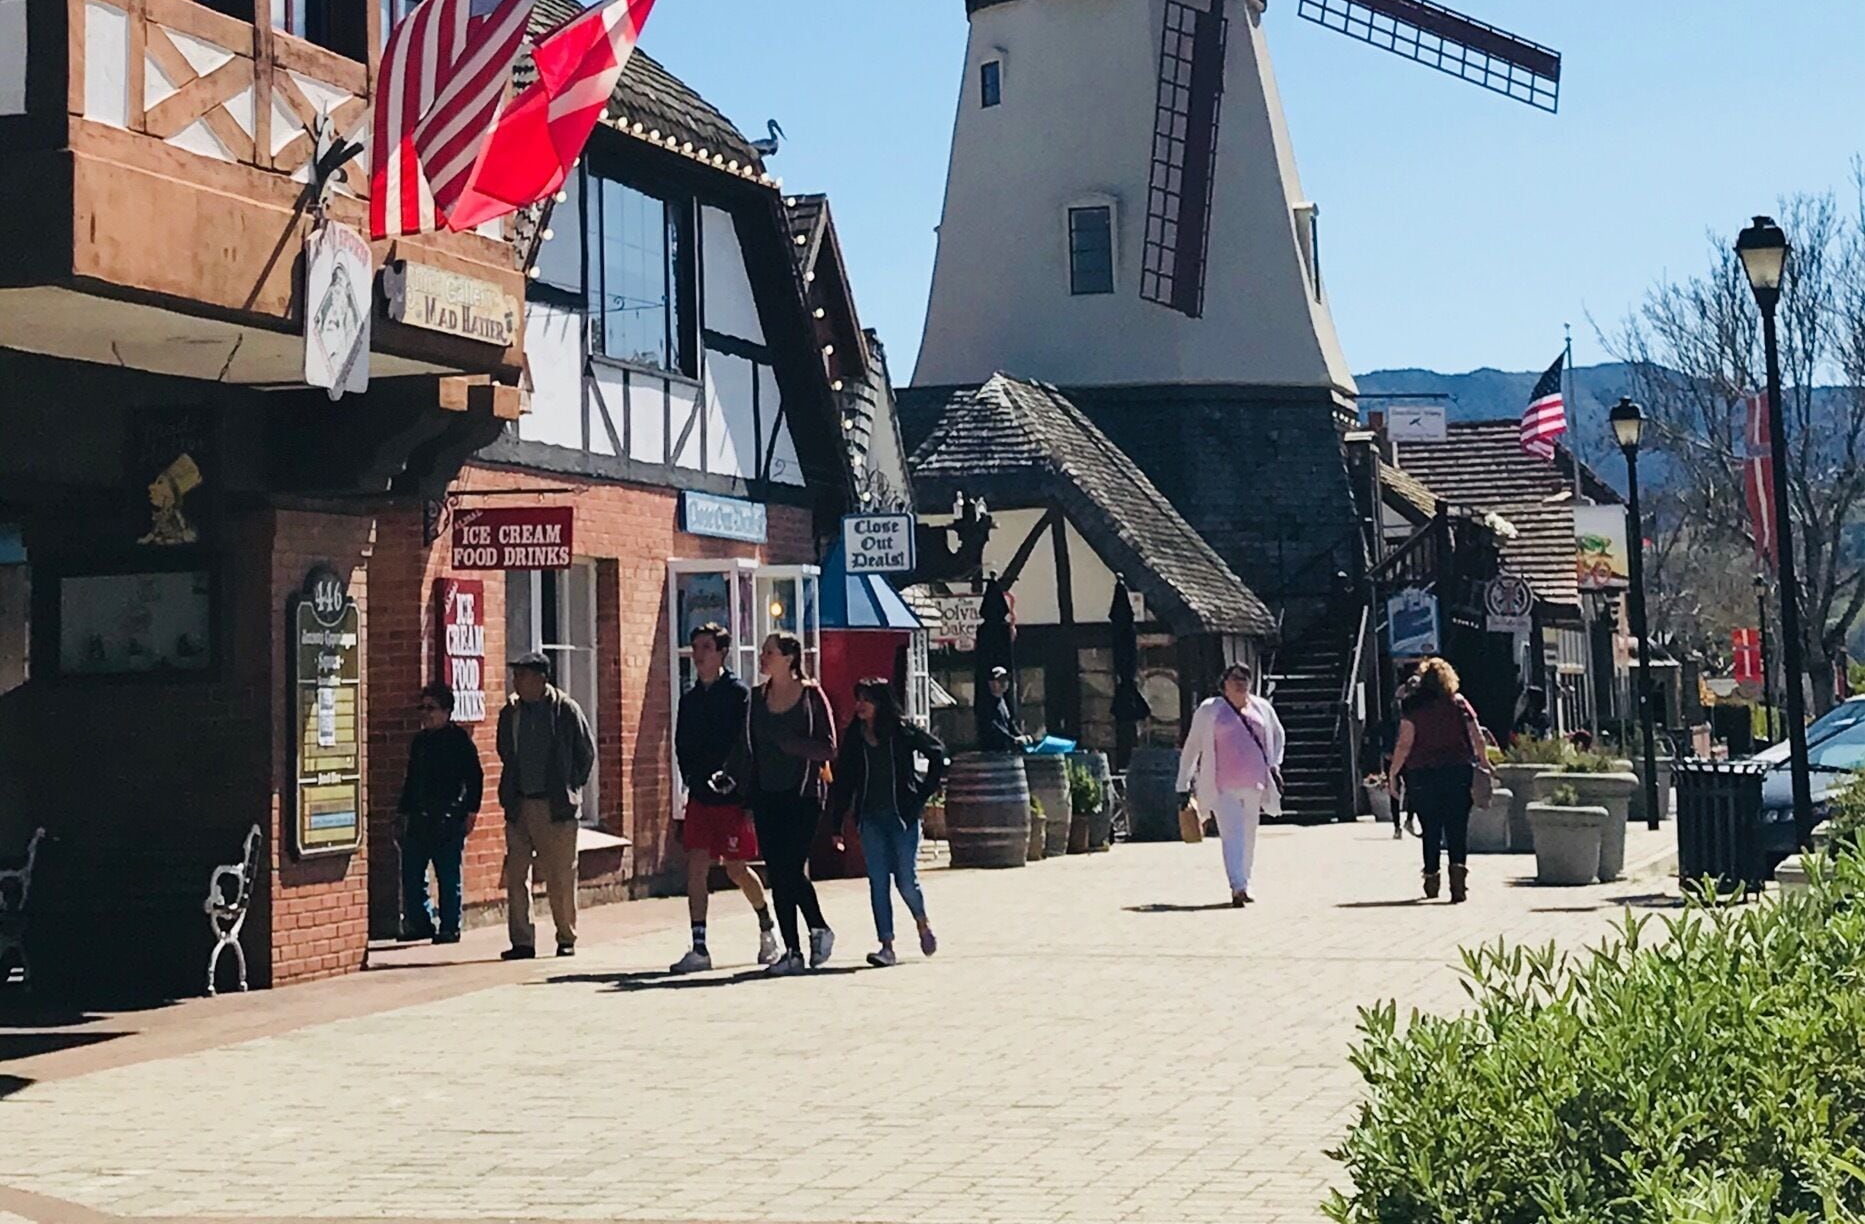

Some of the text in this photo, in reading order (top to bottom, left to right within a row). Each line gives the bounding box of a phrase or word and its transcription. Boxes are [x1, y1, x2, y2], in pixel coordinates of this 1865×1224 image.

[462, 524, 562, 545] ICE CREAM
[854, 519, 900, 535] Close
[452, 546, 570, 567] FOOD DRINKS
[860, 536, 894, 551] Out
[851, 551, 905, 569] Deals!
[315, 580, 343, 613] 446
[455, 593, 475, 625] ICE
[446, 624, 485, 656] CREAM
[451, 658, 480, 690] FOOD
[450, 690, 486, 722] RINKS
